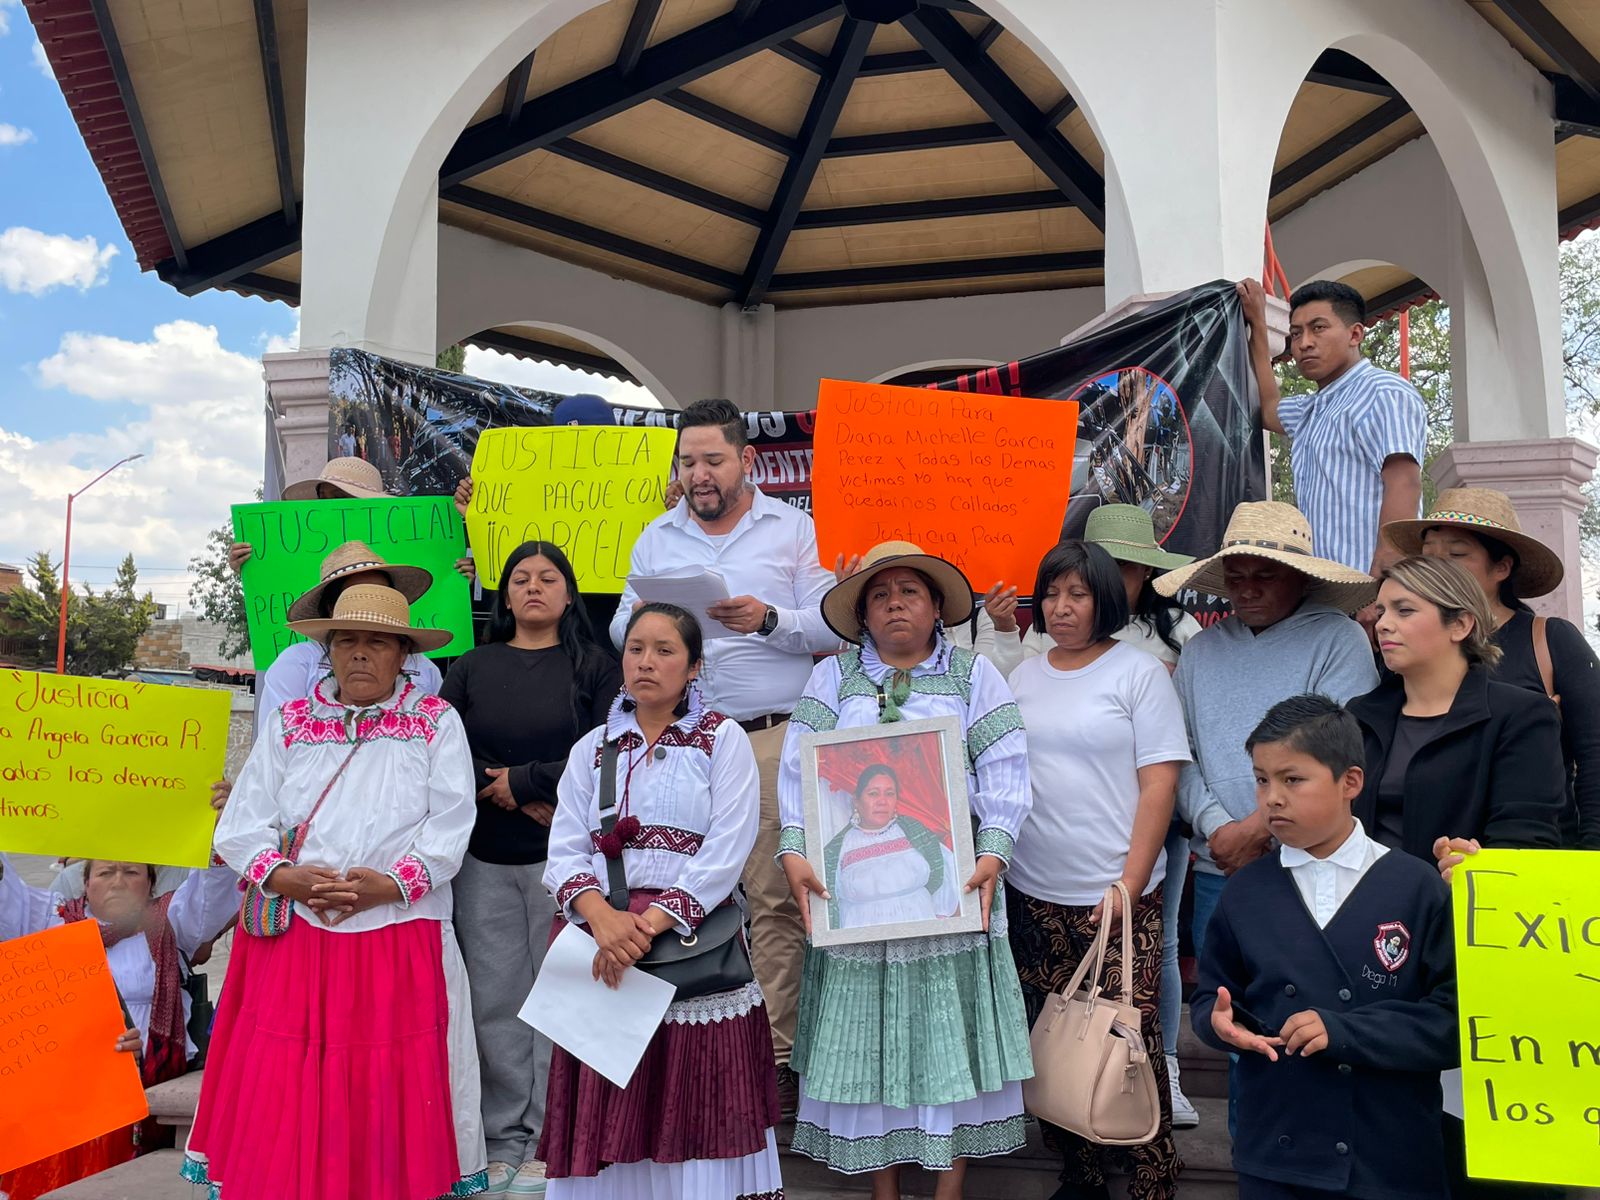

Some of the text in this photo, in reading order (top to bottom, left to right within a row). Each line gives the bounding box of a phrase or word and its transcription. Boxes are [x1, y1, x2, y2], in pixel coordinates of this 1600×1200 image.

[951, 396, 994, 422] Para
[836, 422, 895, 447] Diana
[905, 426, 986, 445] Michelle
[477, 429, 651, 473] JUSTICIA
[839, 450, 884, 467] Perez
[916, 451, 960, 467] Todas
[969, 450, 991, 466] las
[1001, 452, 1056, 471] Demas
[476, 475, 668, 515] QUE PAGUE CON
[983, 475, 1014, 493] que
[972, 525, 1014, 546] Para
[28, 717, 89, 759] Angela
[69, 765, 103, 785] las
[113, 767, 186, 790] demas
[1468, 1015, 1543, 1065] En
[1484, 1078, 1555, 1125] los
